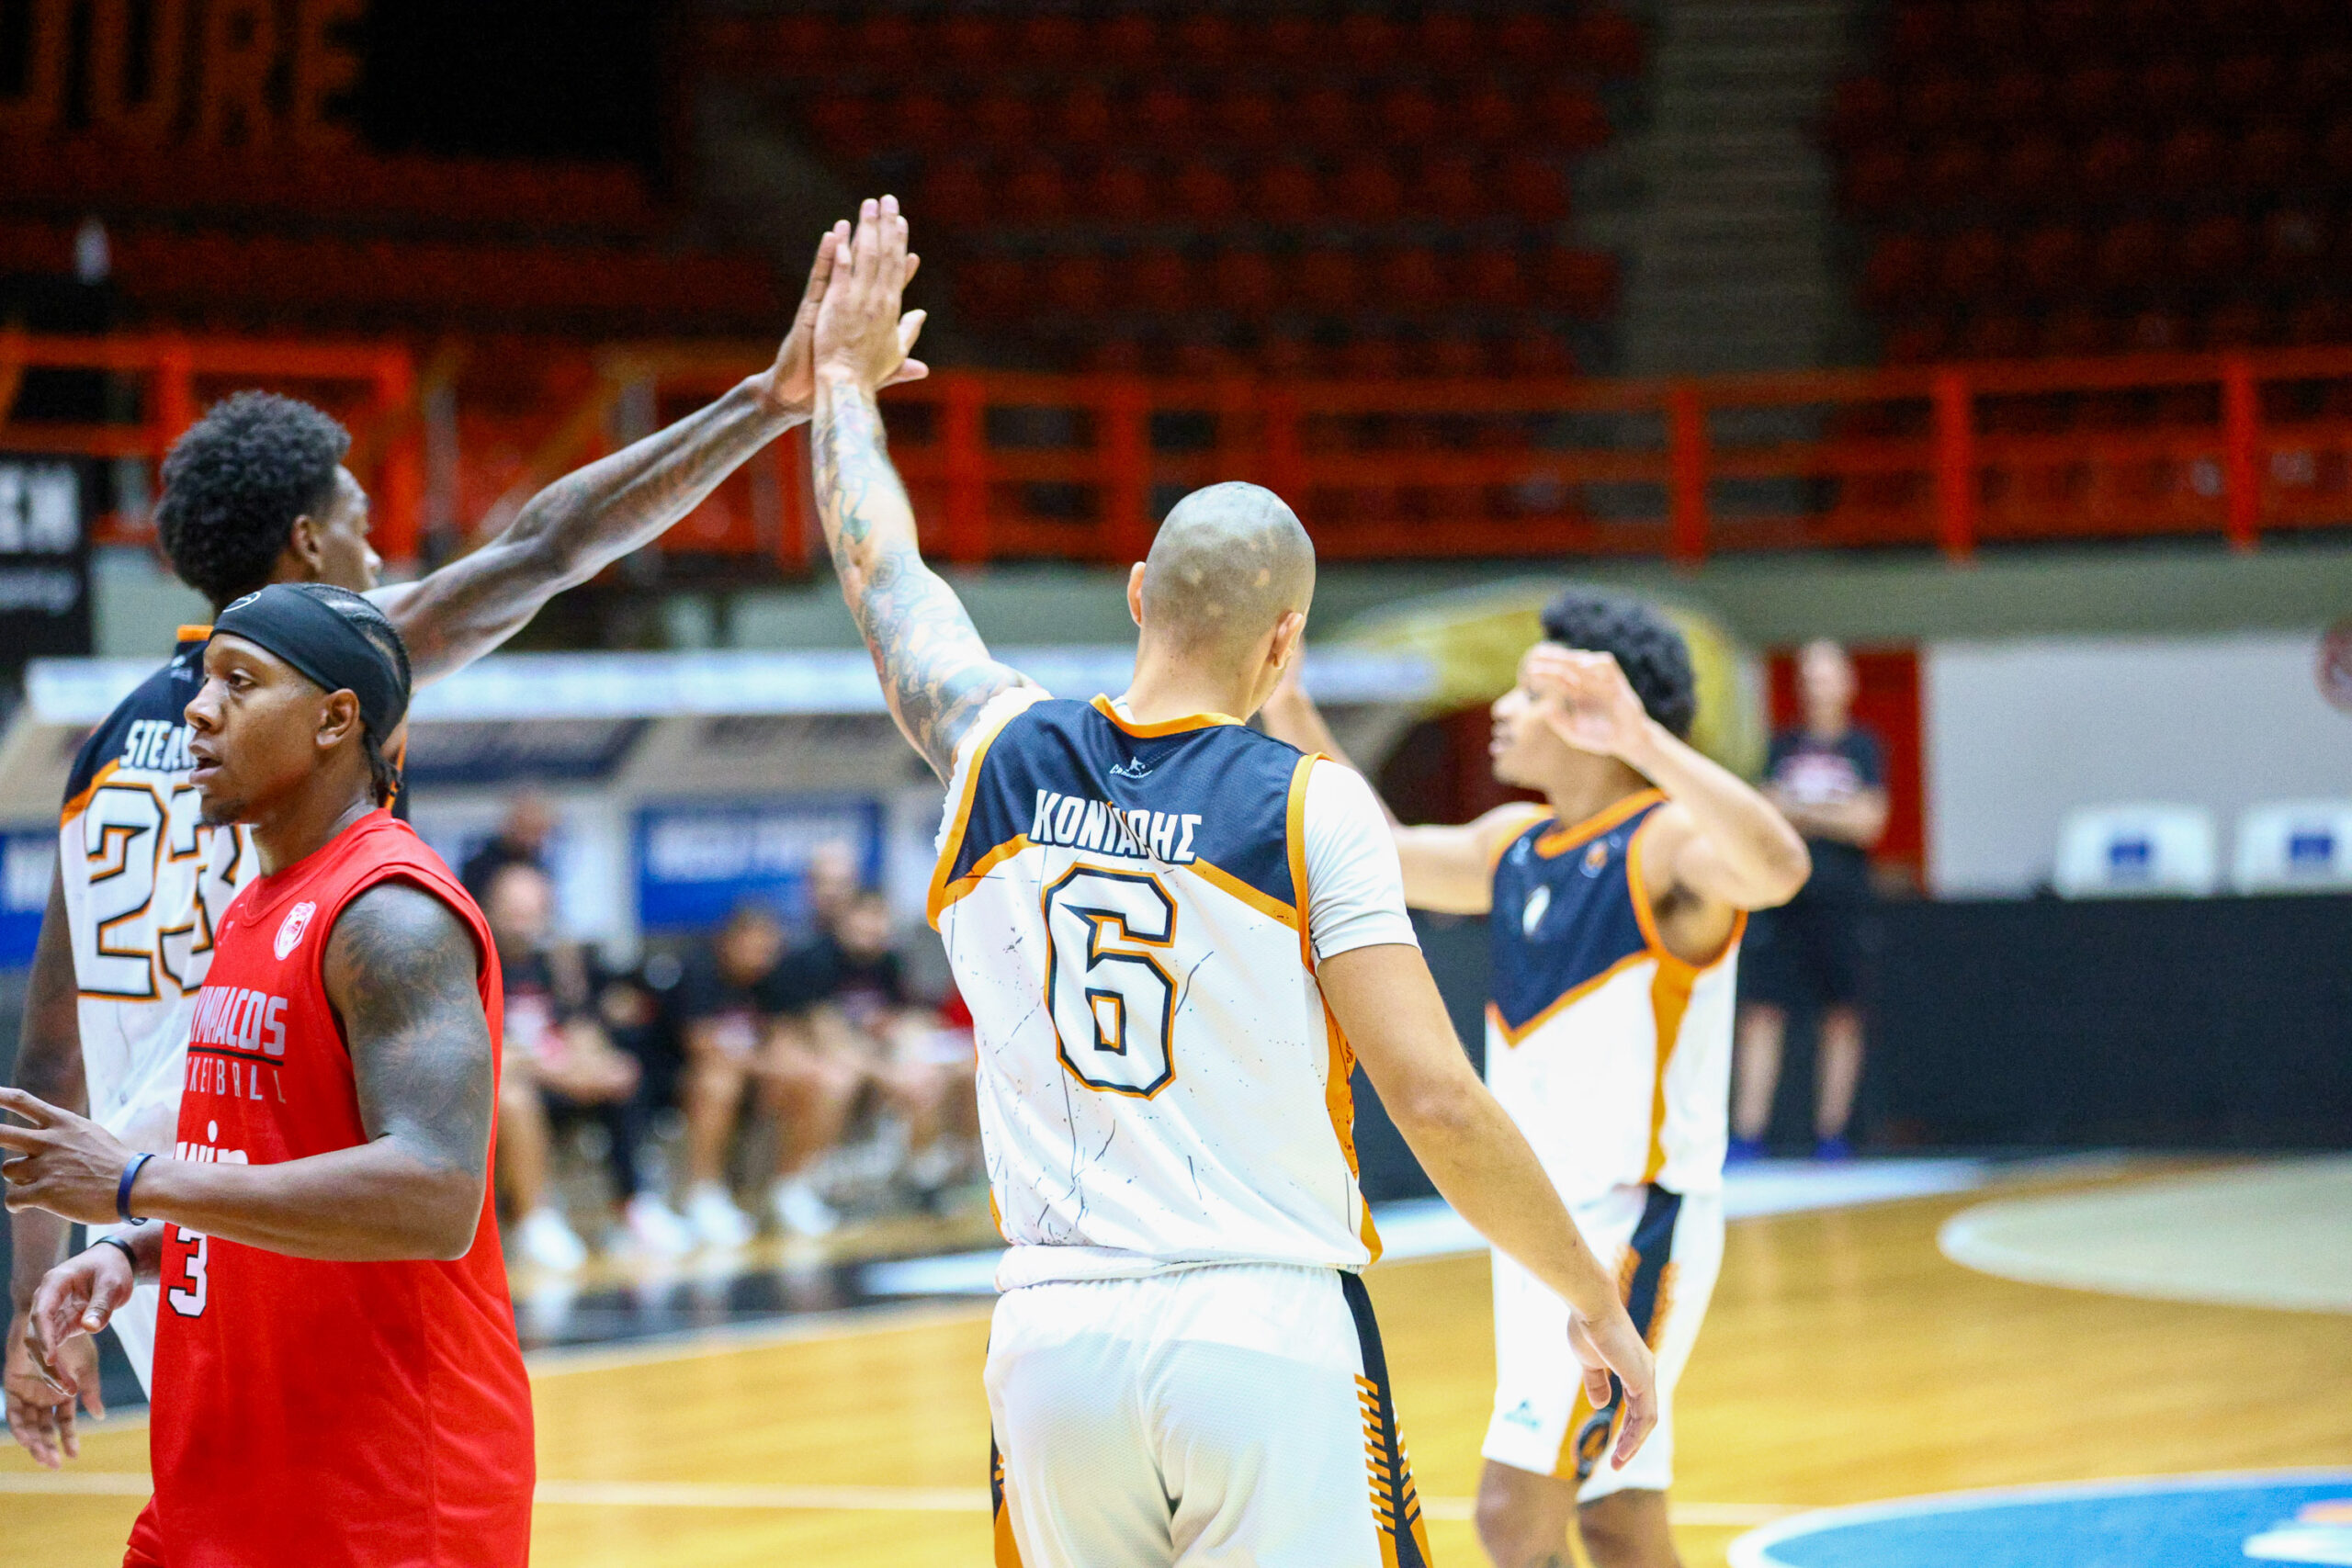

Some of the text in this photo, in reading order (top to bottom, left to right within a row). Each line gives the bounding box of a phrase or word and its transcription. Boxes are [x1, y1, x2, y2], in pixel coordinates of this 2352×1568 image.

[77, 782, 244, 1002] 23
[1040, 862, 1178, 1100] 6
[167, 1226, 209, 1318] 3
